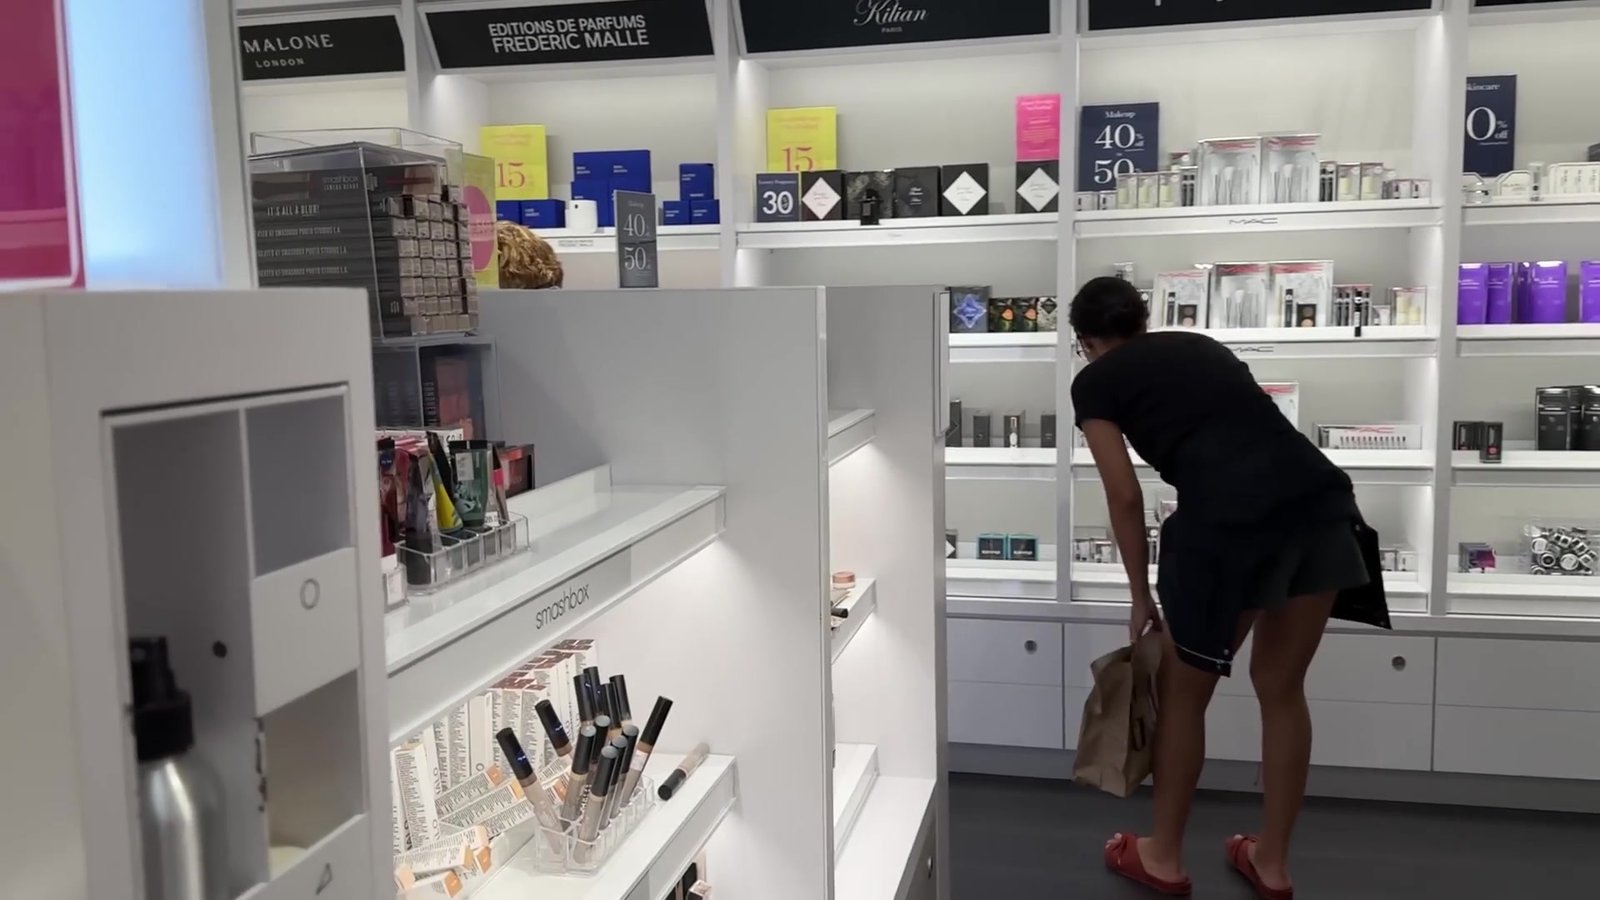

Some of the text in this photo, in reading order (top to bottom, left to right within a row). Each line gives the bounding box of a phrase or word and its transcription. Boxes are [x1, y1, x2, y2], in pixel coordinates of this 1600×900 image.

[853, 0, 929, 26] Kilian
[488, 14, 646, 37] EDITIONS DE PARFUMS
[243, 34, 334, 53] MALONE
[491, 29, 650, 53] FREDERIC MALLE
[255, 57, 305, 68] LONDON
[1093, 123, 1135, 150] 40
[781, 146, 814, 173] 15
[1093, 158, 1135, 184] 50
[497, 162, 526, 189] 15
[281, 205, 293, 216] ALL
[762, 190, 794, 215] 30
[623, 213, 646, 237] 40
[1228, 216, 1279, 225] MAC
[624, 246, 647, 270] 50
[535, 584, 590, 630] smashbox
